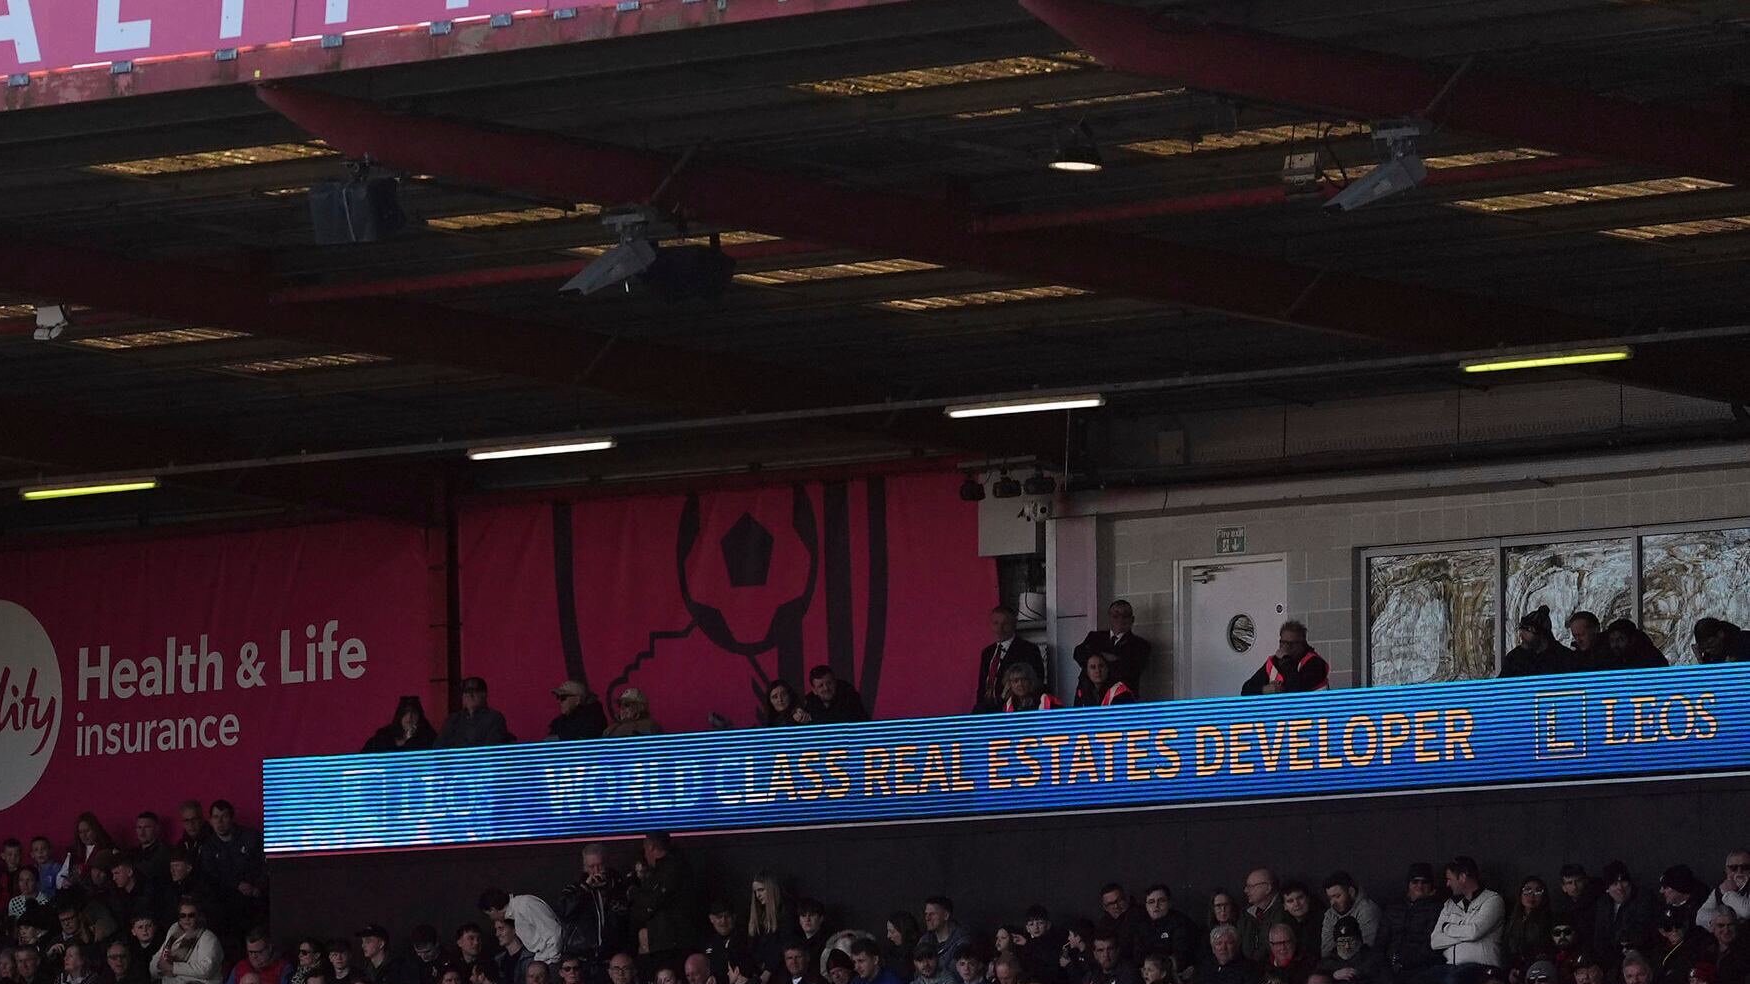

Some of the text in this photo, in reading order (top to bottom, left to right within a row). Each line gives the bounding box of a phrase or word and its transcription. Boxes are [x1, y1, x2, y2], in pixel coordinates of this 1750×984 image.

[77, 620, 367, 702] Health & Life
[76, 712, 240, 757] insurance
[546, 762, 699, 813] WORLD
[716, 750, 850, 804] CLASS
[864, 743, 974, 796] REAL
[988, 728, 1180, 790] ESTATES
[1195, 709, 1475, 776] DEVELOPER
[1601, 693, 1718, 745] LEOS
